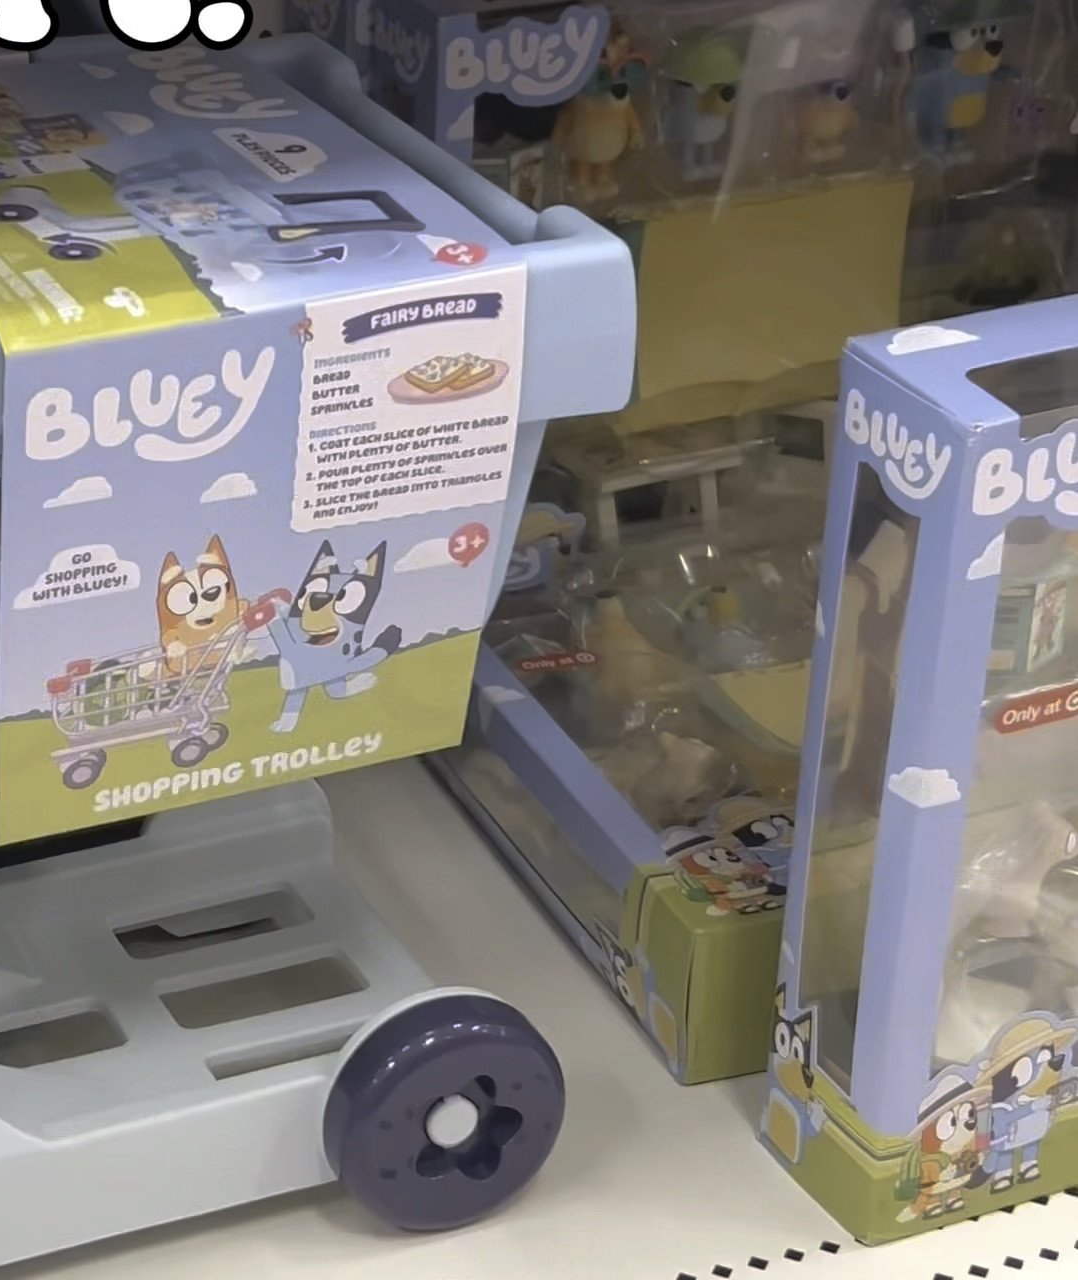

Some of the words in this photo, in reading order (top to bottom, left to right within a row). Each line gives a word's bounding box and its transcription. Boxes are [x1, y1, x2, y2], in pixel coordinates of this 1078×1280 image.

[445, 15, 598, 96] BLUEY
[370, 306, 420, 330] FAIRY
[422, 298, 477, 319] BREAD
[313, 347, 392, 369] INGREDIENTS
[312, 370, 351, 385] BREAD
[25, 346, 276, 462] BLUEY
[310, 397, 374, 416] SPRINKLES
[311, 384, 360, 401] BUTTER
[309, 421, 377, 440] DIRECTIONS
[319, 438, 351, 451] COAT
[352, 433, 382, 446] EACH
[383, 428, 415, 441] SLICE
[416, 423, 431, 436] OF
[433, 420, 470, 434] WHITE
[471, 415, 509, 430] BREAD
[843, 388, 952, 500] BLUEY
[316, 452, 348, 465] WITH
[348, 444, 393, 459] PLENTY
[395, 441, 410, 453] OF
[412, 434, 463, 450] BUTTER.
[318, 466, 350, 480] POUR
[351, 459, 396, 474] PLENTY
[397, 457, 412, 468] OF
[413, 448, 475, 466] SPRINKLES
[477, 443, 508, 456] OVER
[315, 495, 346, 508] SLICE
[348, 490, 371, 502] THE
[372, 485, 409, 499] BREAD
[410, 480, 438, 492] INTO
[440, 470, 502, 488] TRIANGLES
[316, 481, 339, 492] THE
[341, 476, 362, 488] TOP
[363, 473, 379, 485] OF
[380, 470, 409, 482] EACH
[410, 464, 445, 478] SLICE.
[313, 508, 335, 519] AND
[337, 501, 379, 516] ENJOY!
[452, 530, 484, 553] 3+
[71, 552, 92, 565] GO
[32, 586, 71, 601] WITH
[73, 574, 128, 595] BLUEY!
[45, 562, 117, 585] SHOPPING
[1002, 705, 1041, 727] Only
[1043, 698, 1062, 715] at
[93, 762, 245, 812] SHOPPING
[251, 732, 383, 778] TROLLEY
